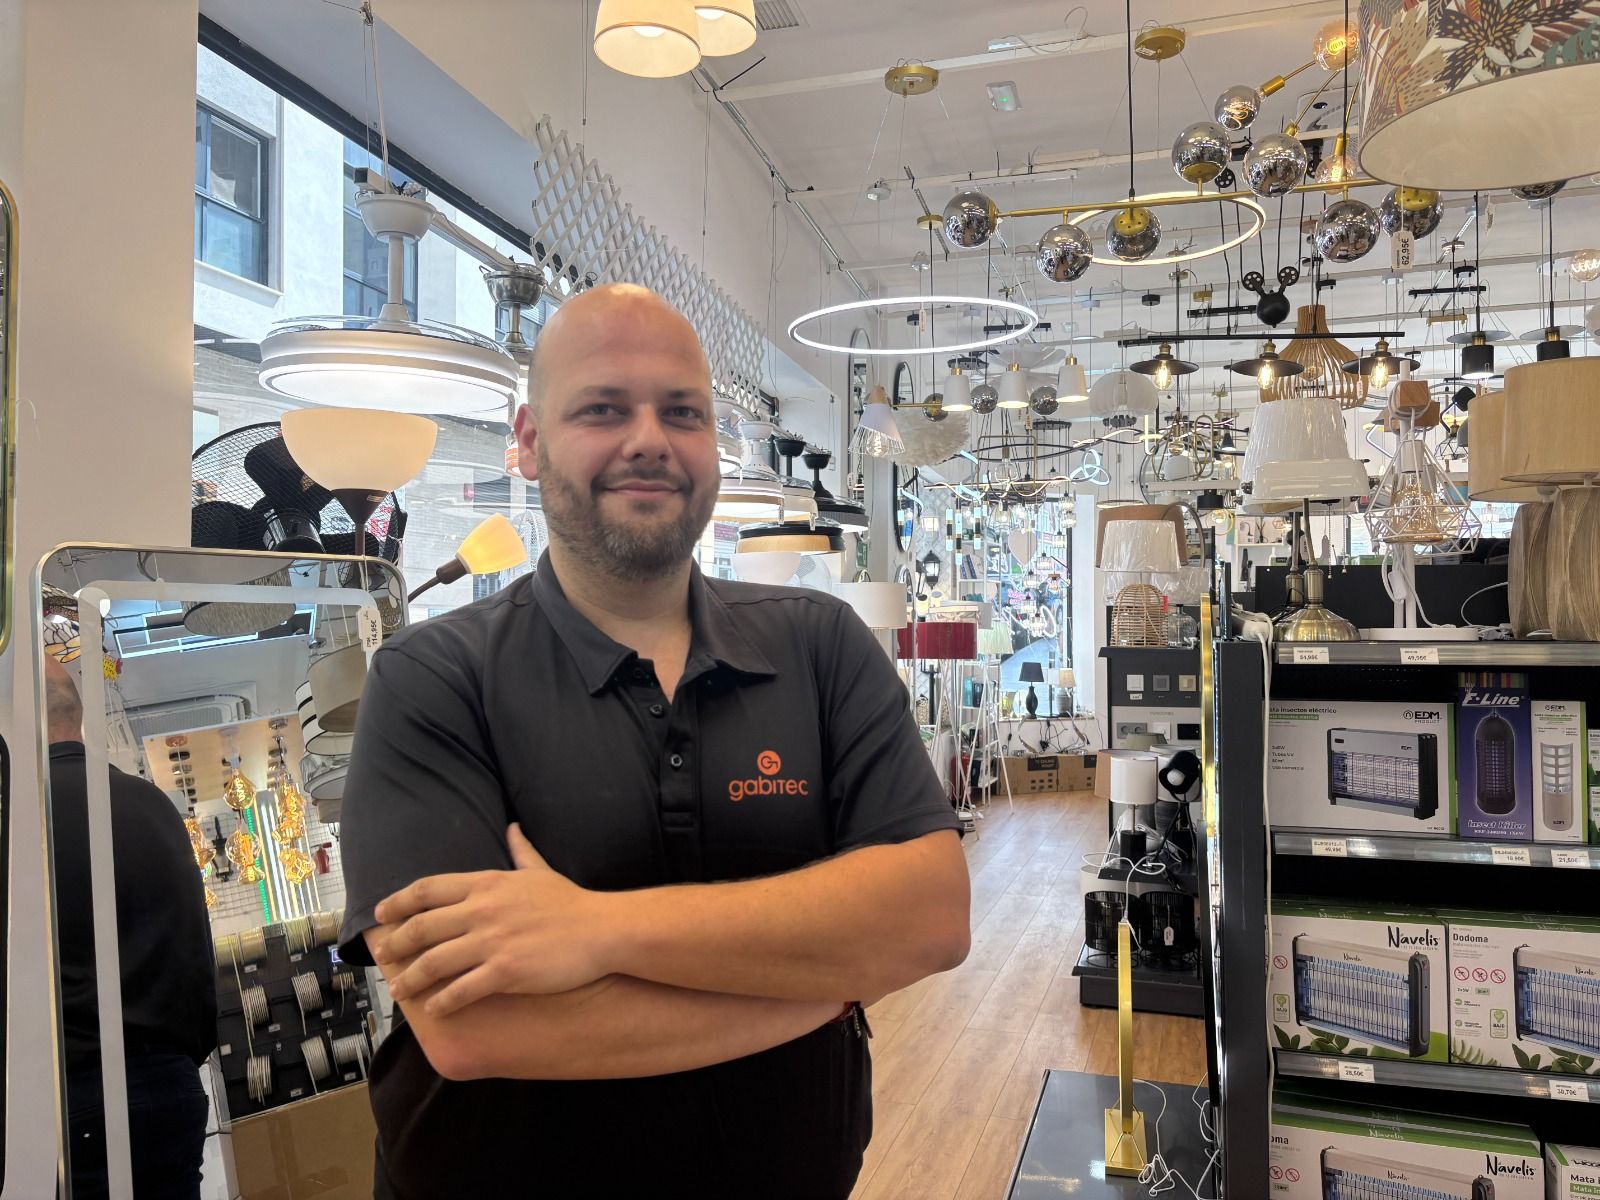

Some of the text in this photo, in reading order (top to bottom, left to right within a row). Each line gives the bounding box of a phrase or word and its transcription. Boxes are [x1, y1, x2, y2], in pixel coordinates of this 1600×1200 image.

[1401, 238, 1410, 266] 62,95€
[1308, 706, 1337, 714] eléctrico
[1414, 711, 1440, 720] EDM
[729, 776, 808, 801] gabitec
[1468, 819, 1527, 830] Insect Killer
[1387, 925, 1440, 948] Navelis
[1453, 933, 1489, 943] Dodoma
[1486, 1154, 1535, 1177] Navelis
[1570, 1174, 1595, 1184] Mata
[1573, 1185, 1593, 1193] Mata
